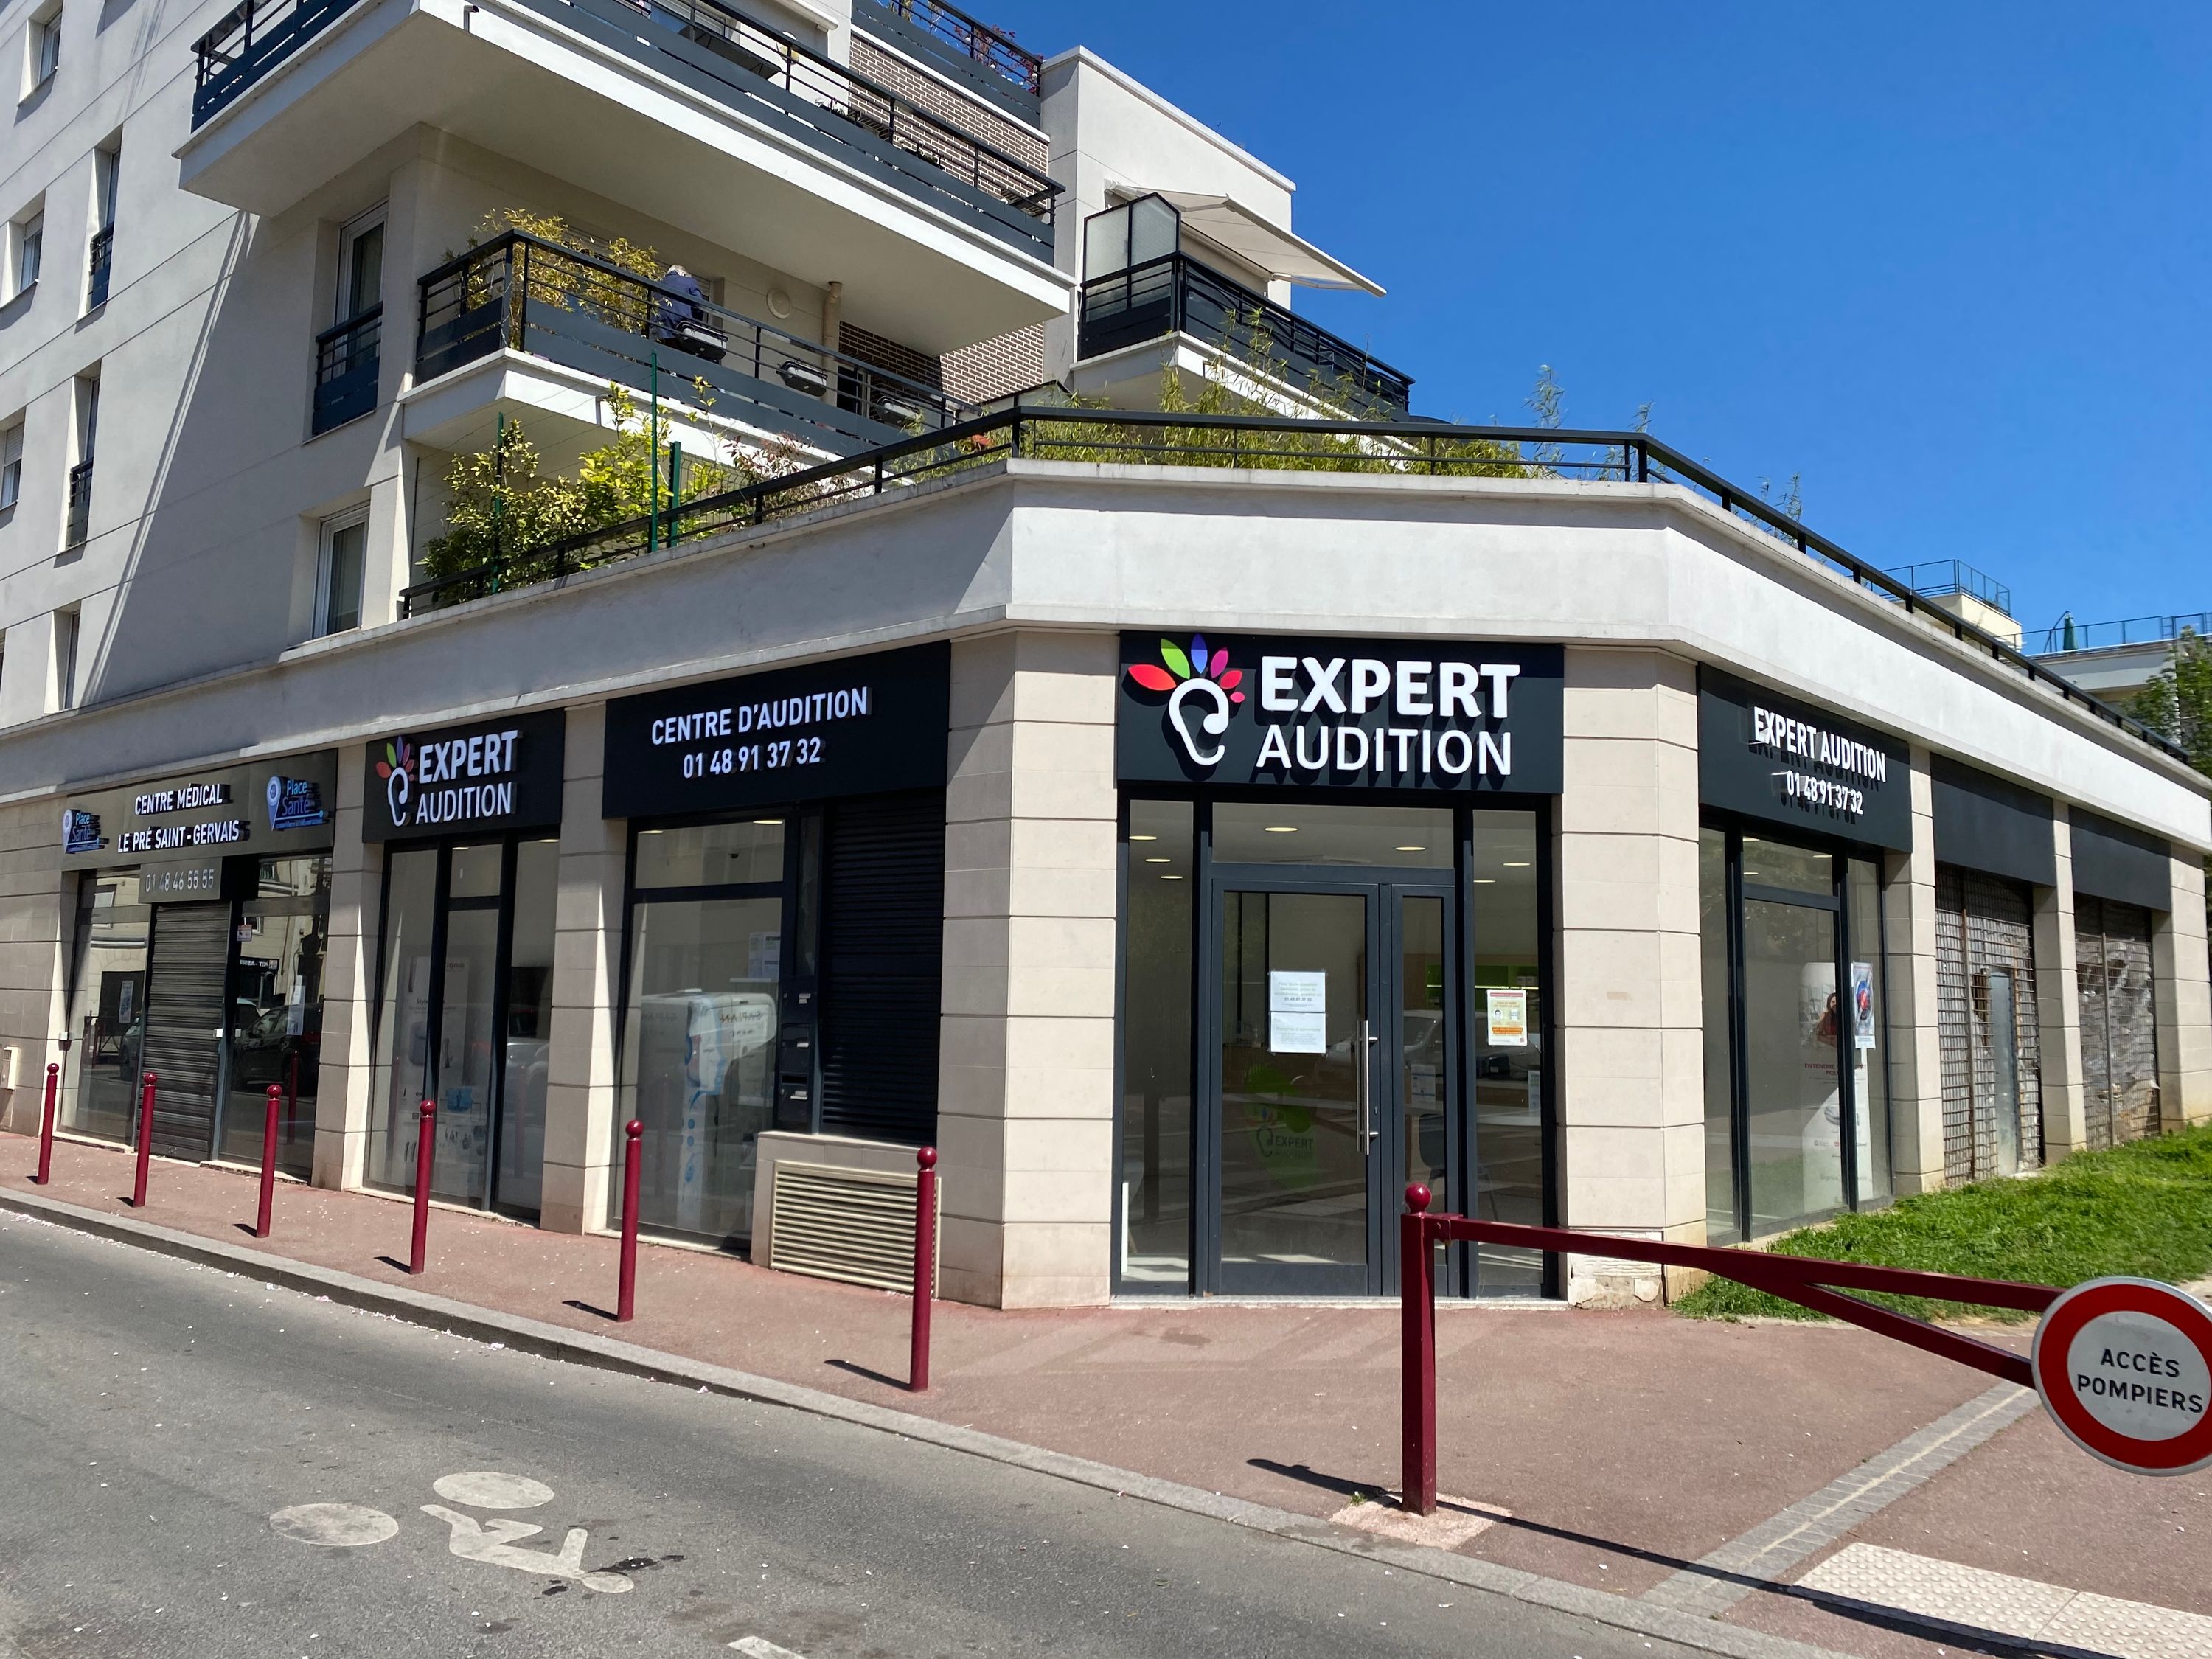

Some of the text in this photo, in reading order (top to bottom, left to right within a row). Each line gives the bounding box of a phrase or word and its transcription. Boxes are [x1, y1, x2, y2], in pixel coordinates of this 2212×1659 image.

[1260, 655, 1520, 719] EXPERT
[652, 686, 869, 745] CENTRE D'AUDITION
[418, 730, 518, 784] EXPERT
[682, 737, 821, 779] 01 48 91 37 32
[1256, 724, 1512, 776] AUDITION
[1753, 706, 1887, 783] EXPERT AUDITION
[135, 783, 223, 815] CENTRE MÉDICAL
[282, 793, 311, 816] Santé
[286, 779, 308, 796] Place
[416, 782, 512, 824] AUDITION
[1787, 770, 1863, 815] 01 48 91 37 32
[75, 813, 91, 825] Place
[118, 833, 129, 853] LE
[133, 828, 152, 851] PRÉ
[145, 869, 215, 893] 01 48 46 55 55
[1275, 1135, 1314, 1149] EXPERT
[2101, 1348, 2180, 1378] ACCÈS
[2077, 1374, 2204, 1413] POMPIERS
